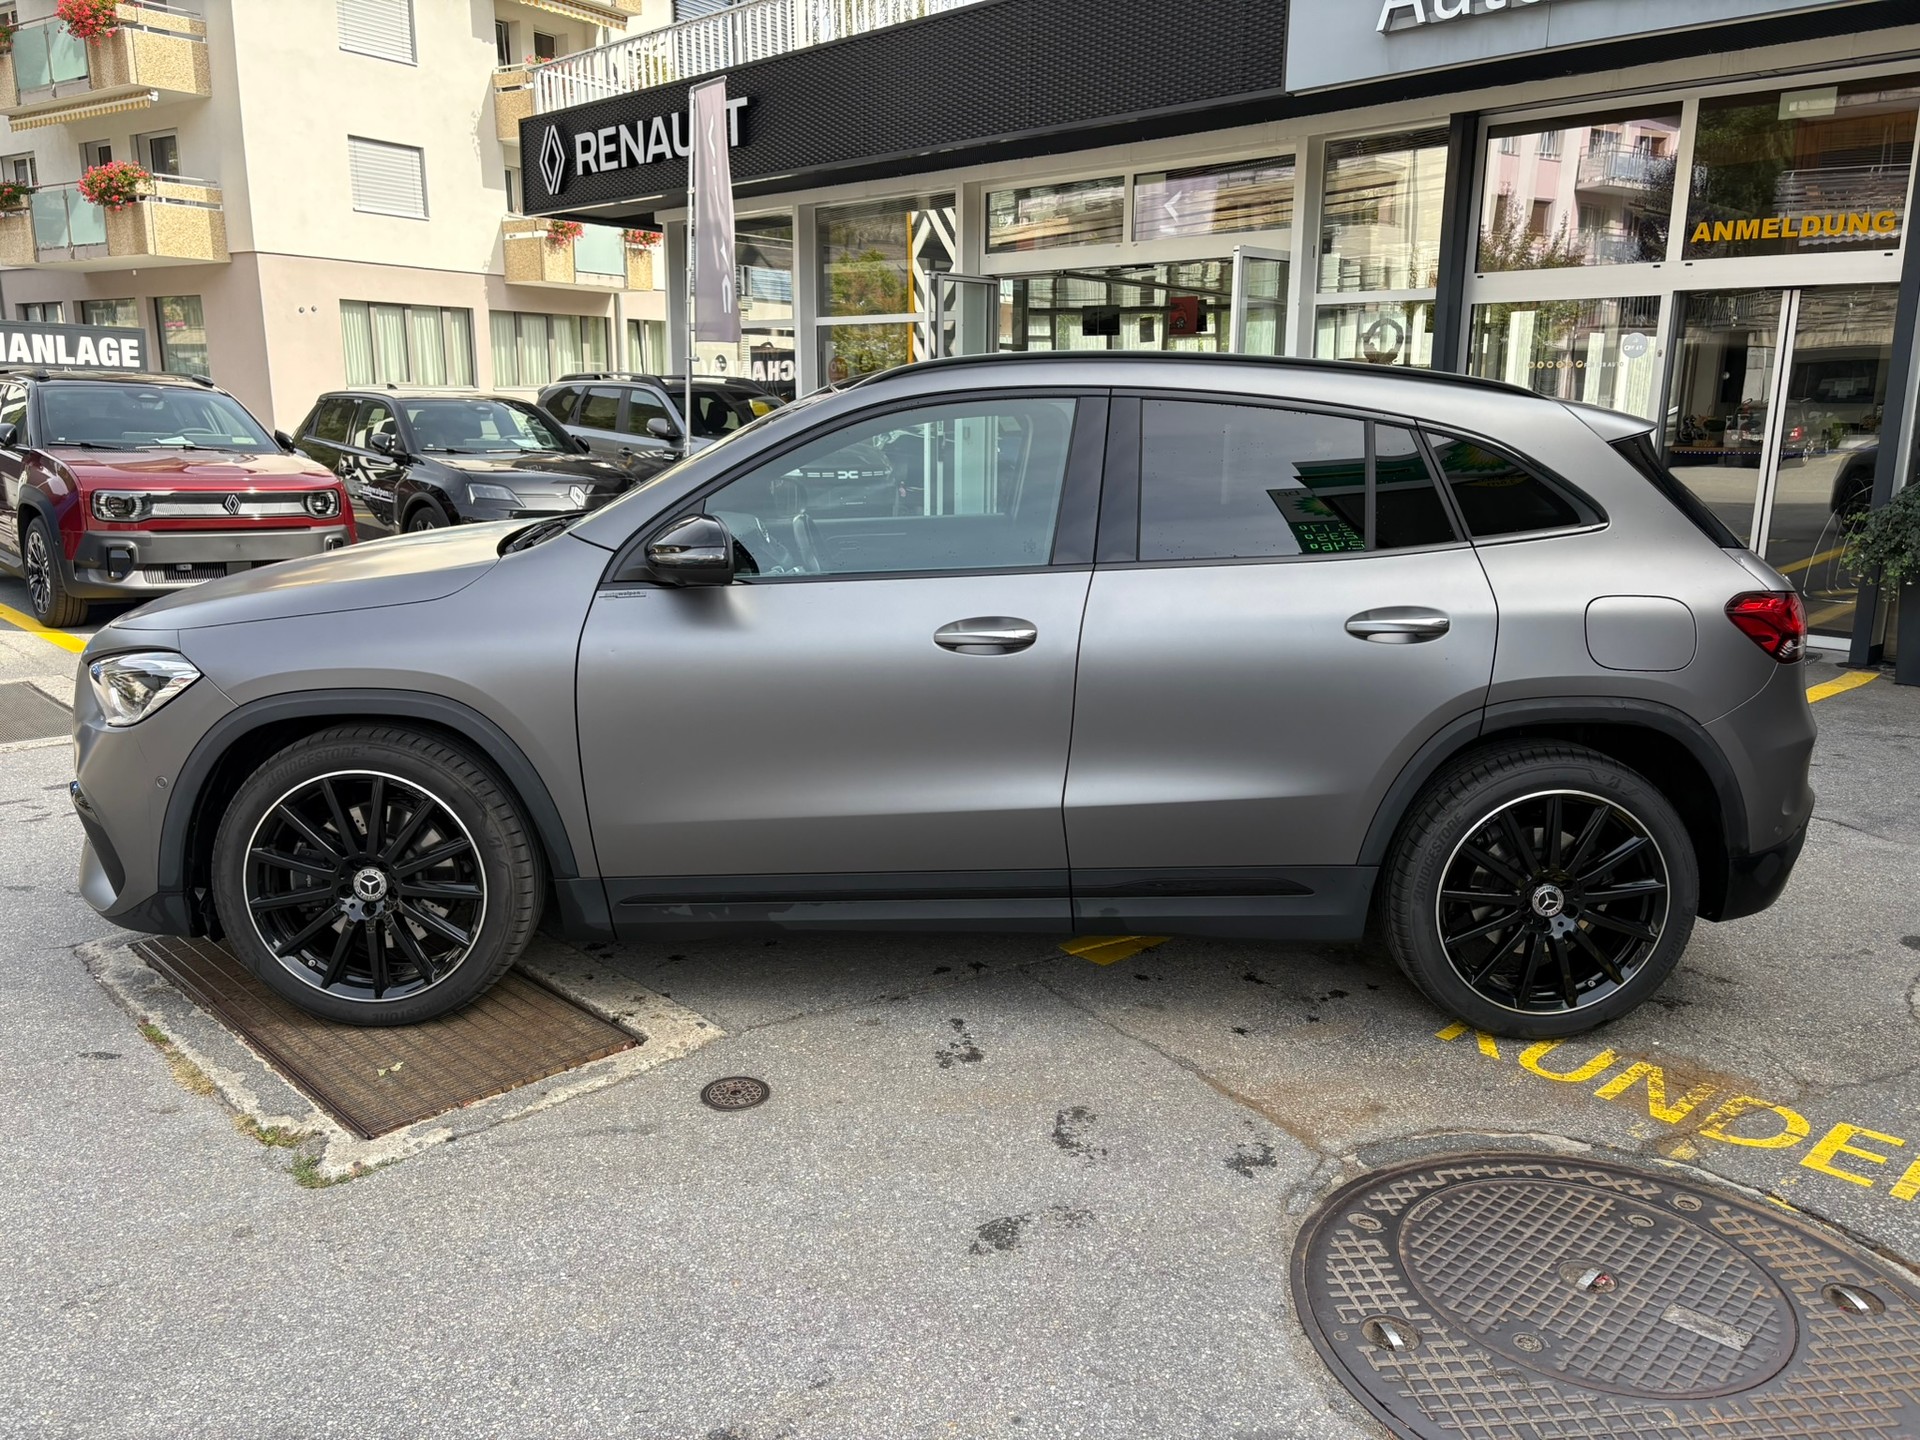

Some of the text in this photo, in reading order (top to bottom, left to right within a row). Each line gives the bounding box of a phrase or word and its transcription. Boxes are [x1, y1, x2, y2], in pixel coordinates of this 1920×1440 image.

[574, 96, 748, 176] RENAUT
[1690, 210, 1897, 243] ANMELDUNG
[1413, 812, 1464, 905] BRIDGESTONE
[1434, 1022, 1920, 1200] UNDE
